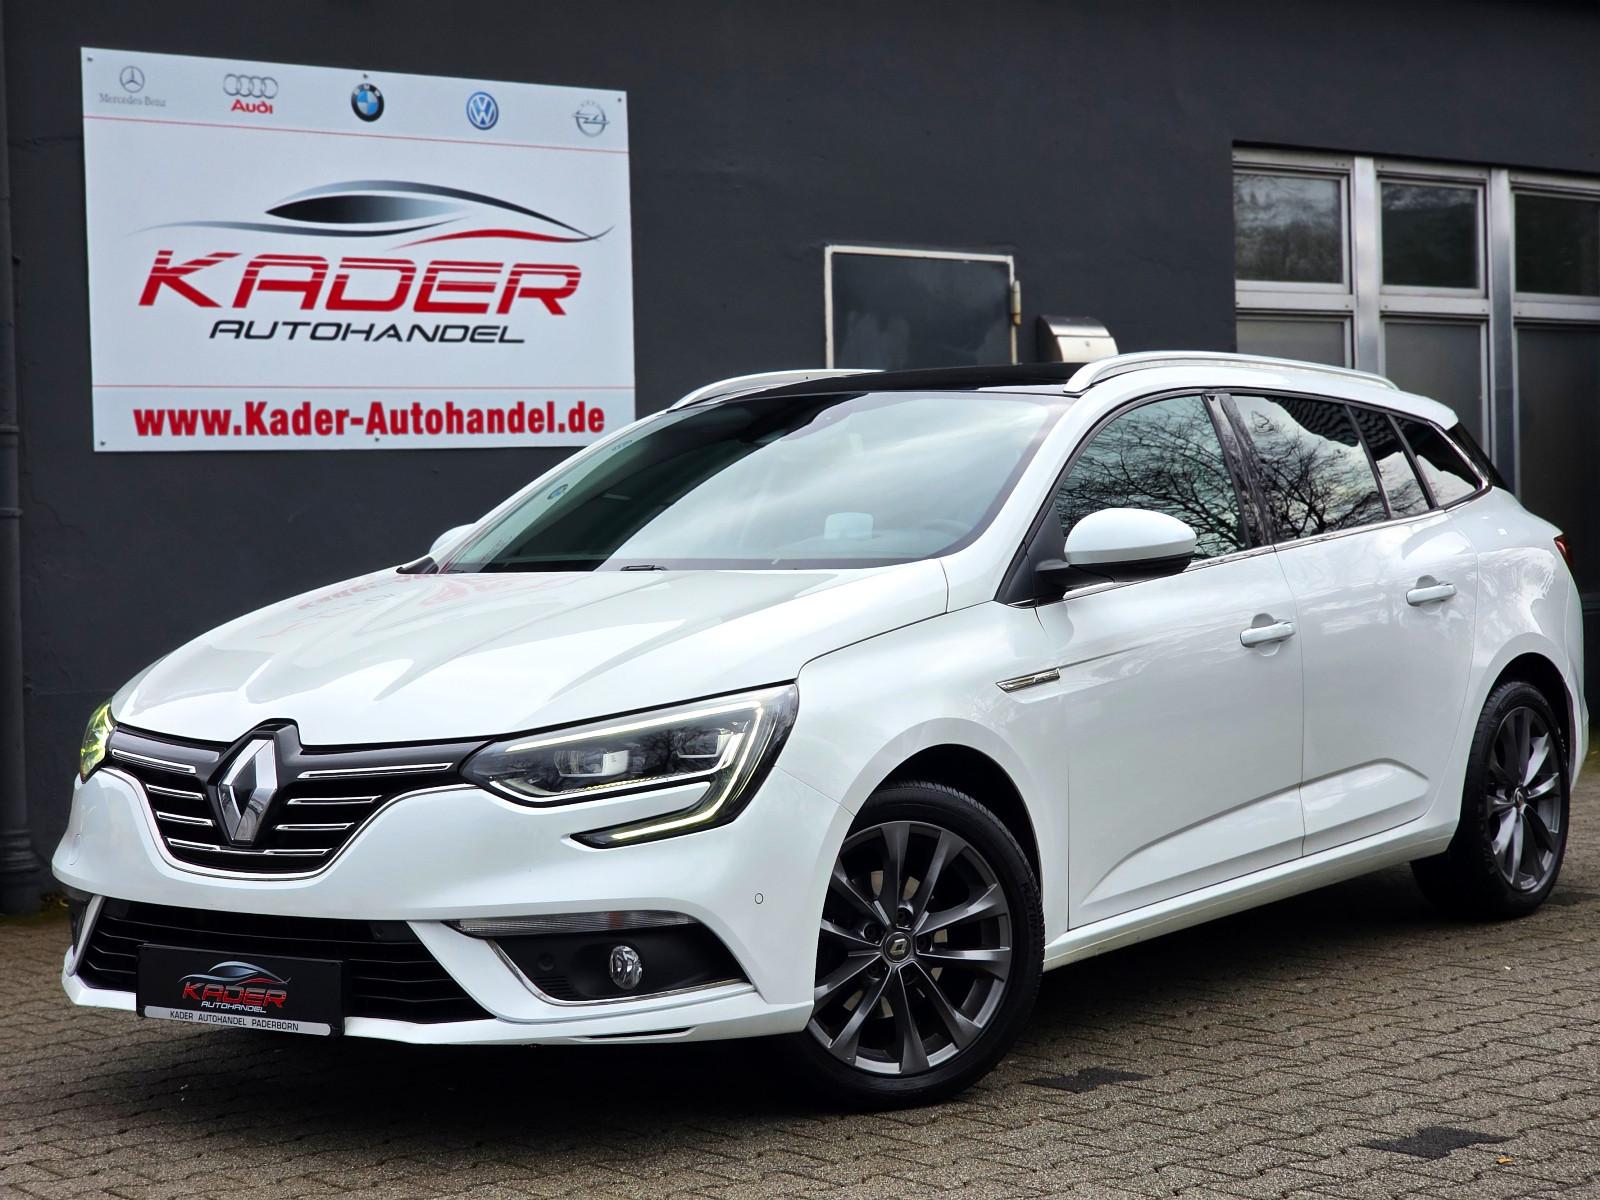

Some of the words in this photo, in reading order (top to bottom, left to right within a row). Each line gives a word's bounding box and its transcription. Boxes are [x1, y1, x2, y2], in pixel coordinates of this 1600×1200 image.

[231, 99, 273, 114] Audi
[138, 249, 582, 316] KADER
[209, 320, 525, 344] AUTOHANDEL
[133, 400, 606, 437] www.Kader-Autohandel.de
[182, 981, 287, 1009] KADER
[201, 1001, 267, 1014] AUTOHANDEL
[170, 1011, 194, 1020] KADER
[198, 1014, 247, 1026] AUTOHANDEL
[251, 1019, 299, 1031] PADERBORN
